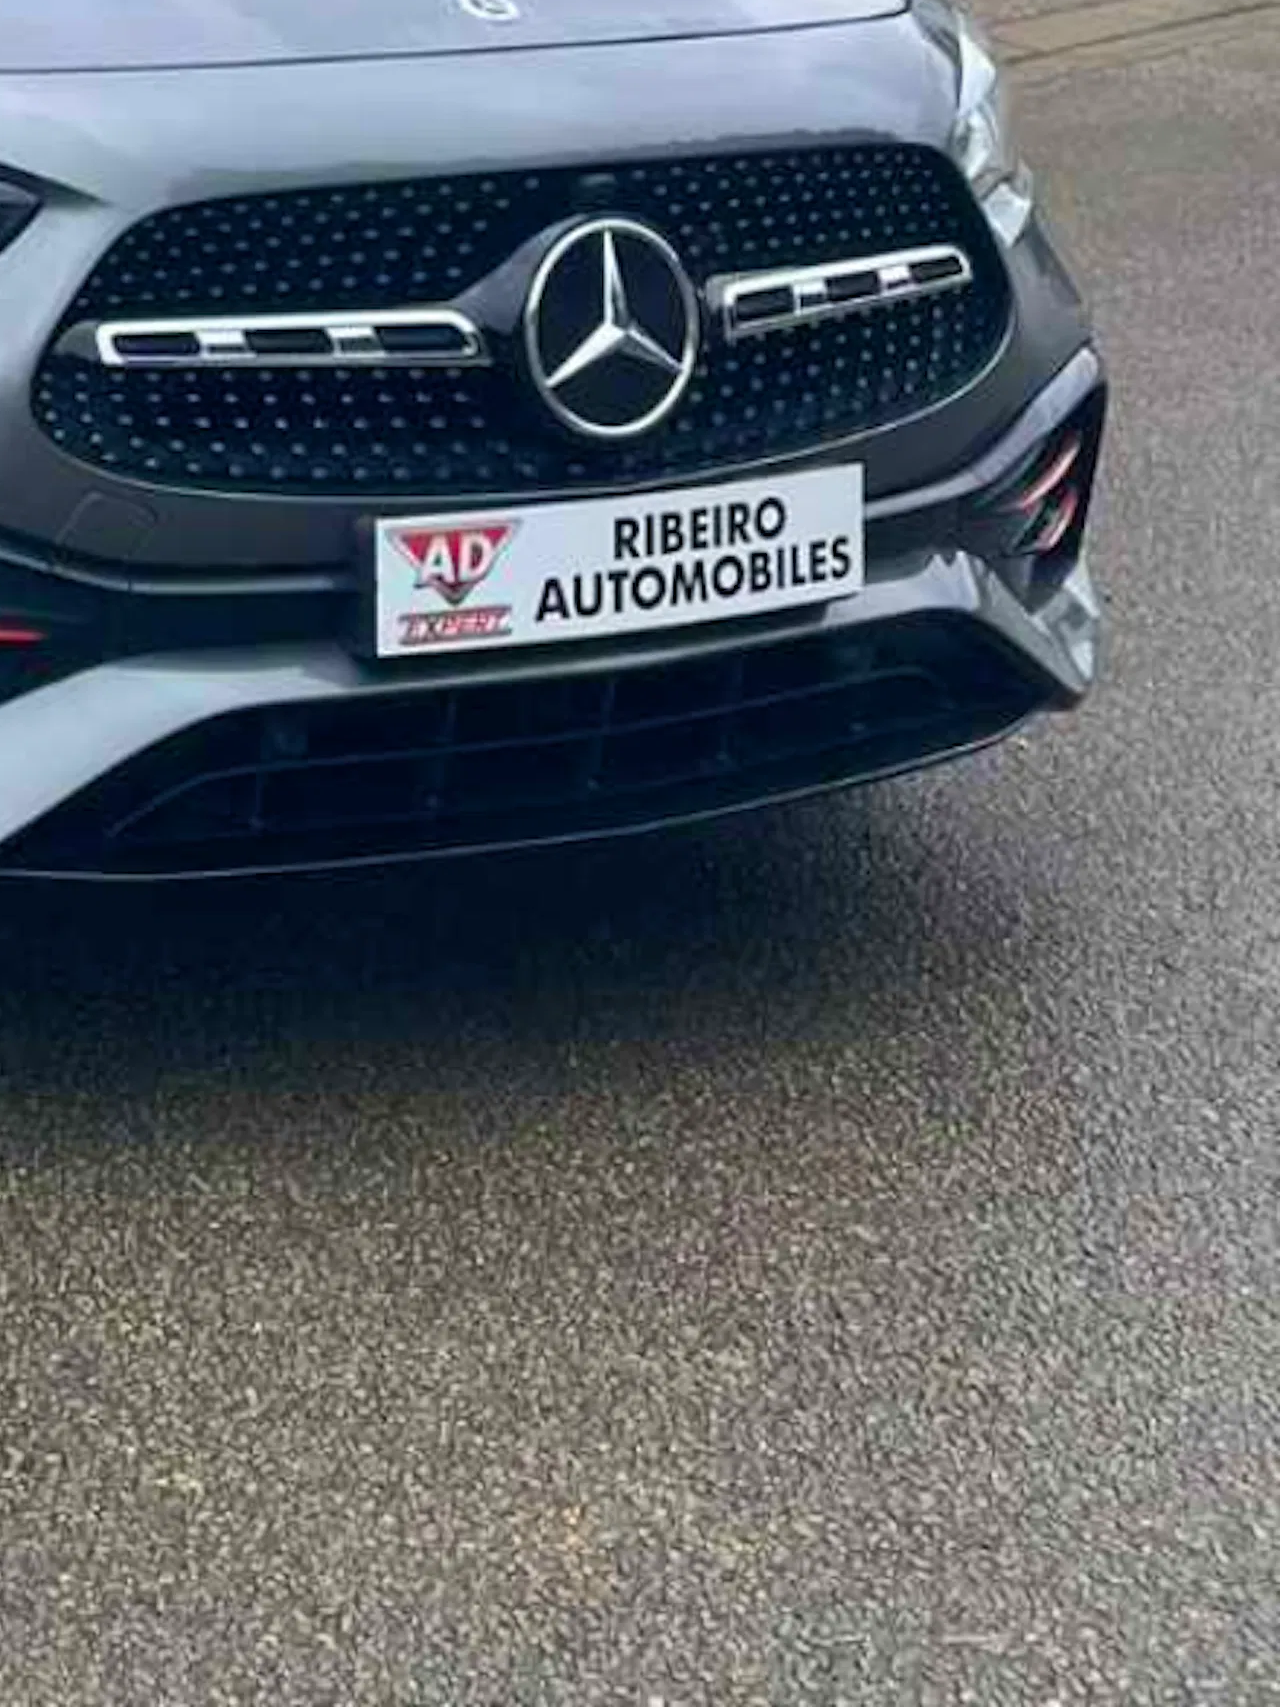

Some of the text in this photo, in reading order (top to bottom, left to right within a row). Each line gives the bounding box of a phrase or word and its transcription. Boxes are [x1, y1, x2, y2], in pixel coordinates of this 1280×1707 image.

[414, 530, 495, 589] AD
[614, 496, 788, 562] RIBEIRO
[535, 536, 851, 624] AUTOMOBILES
